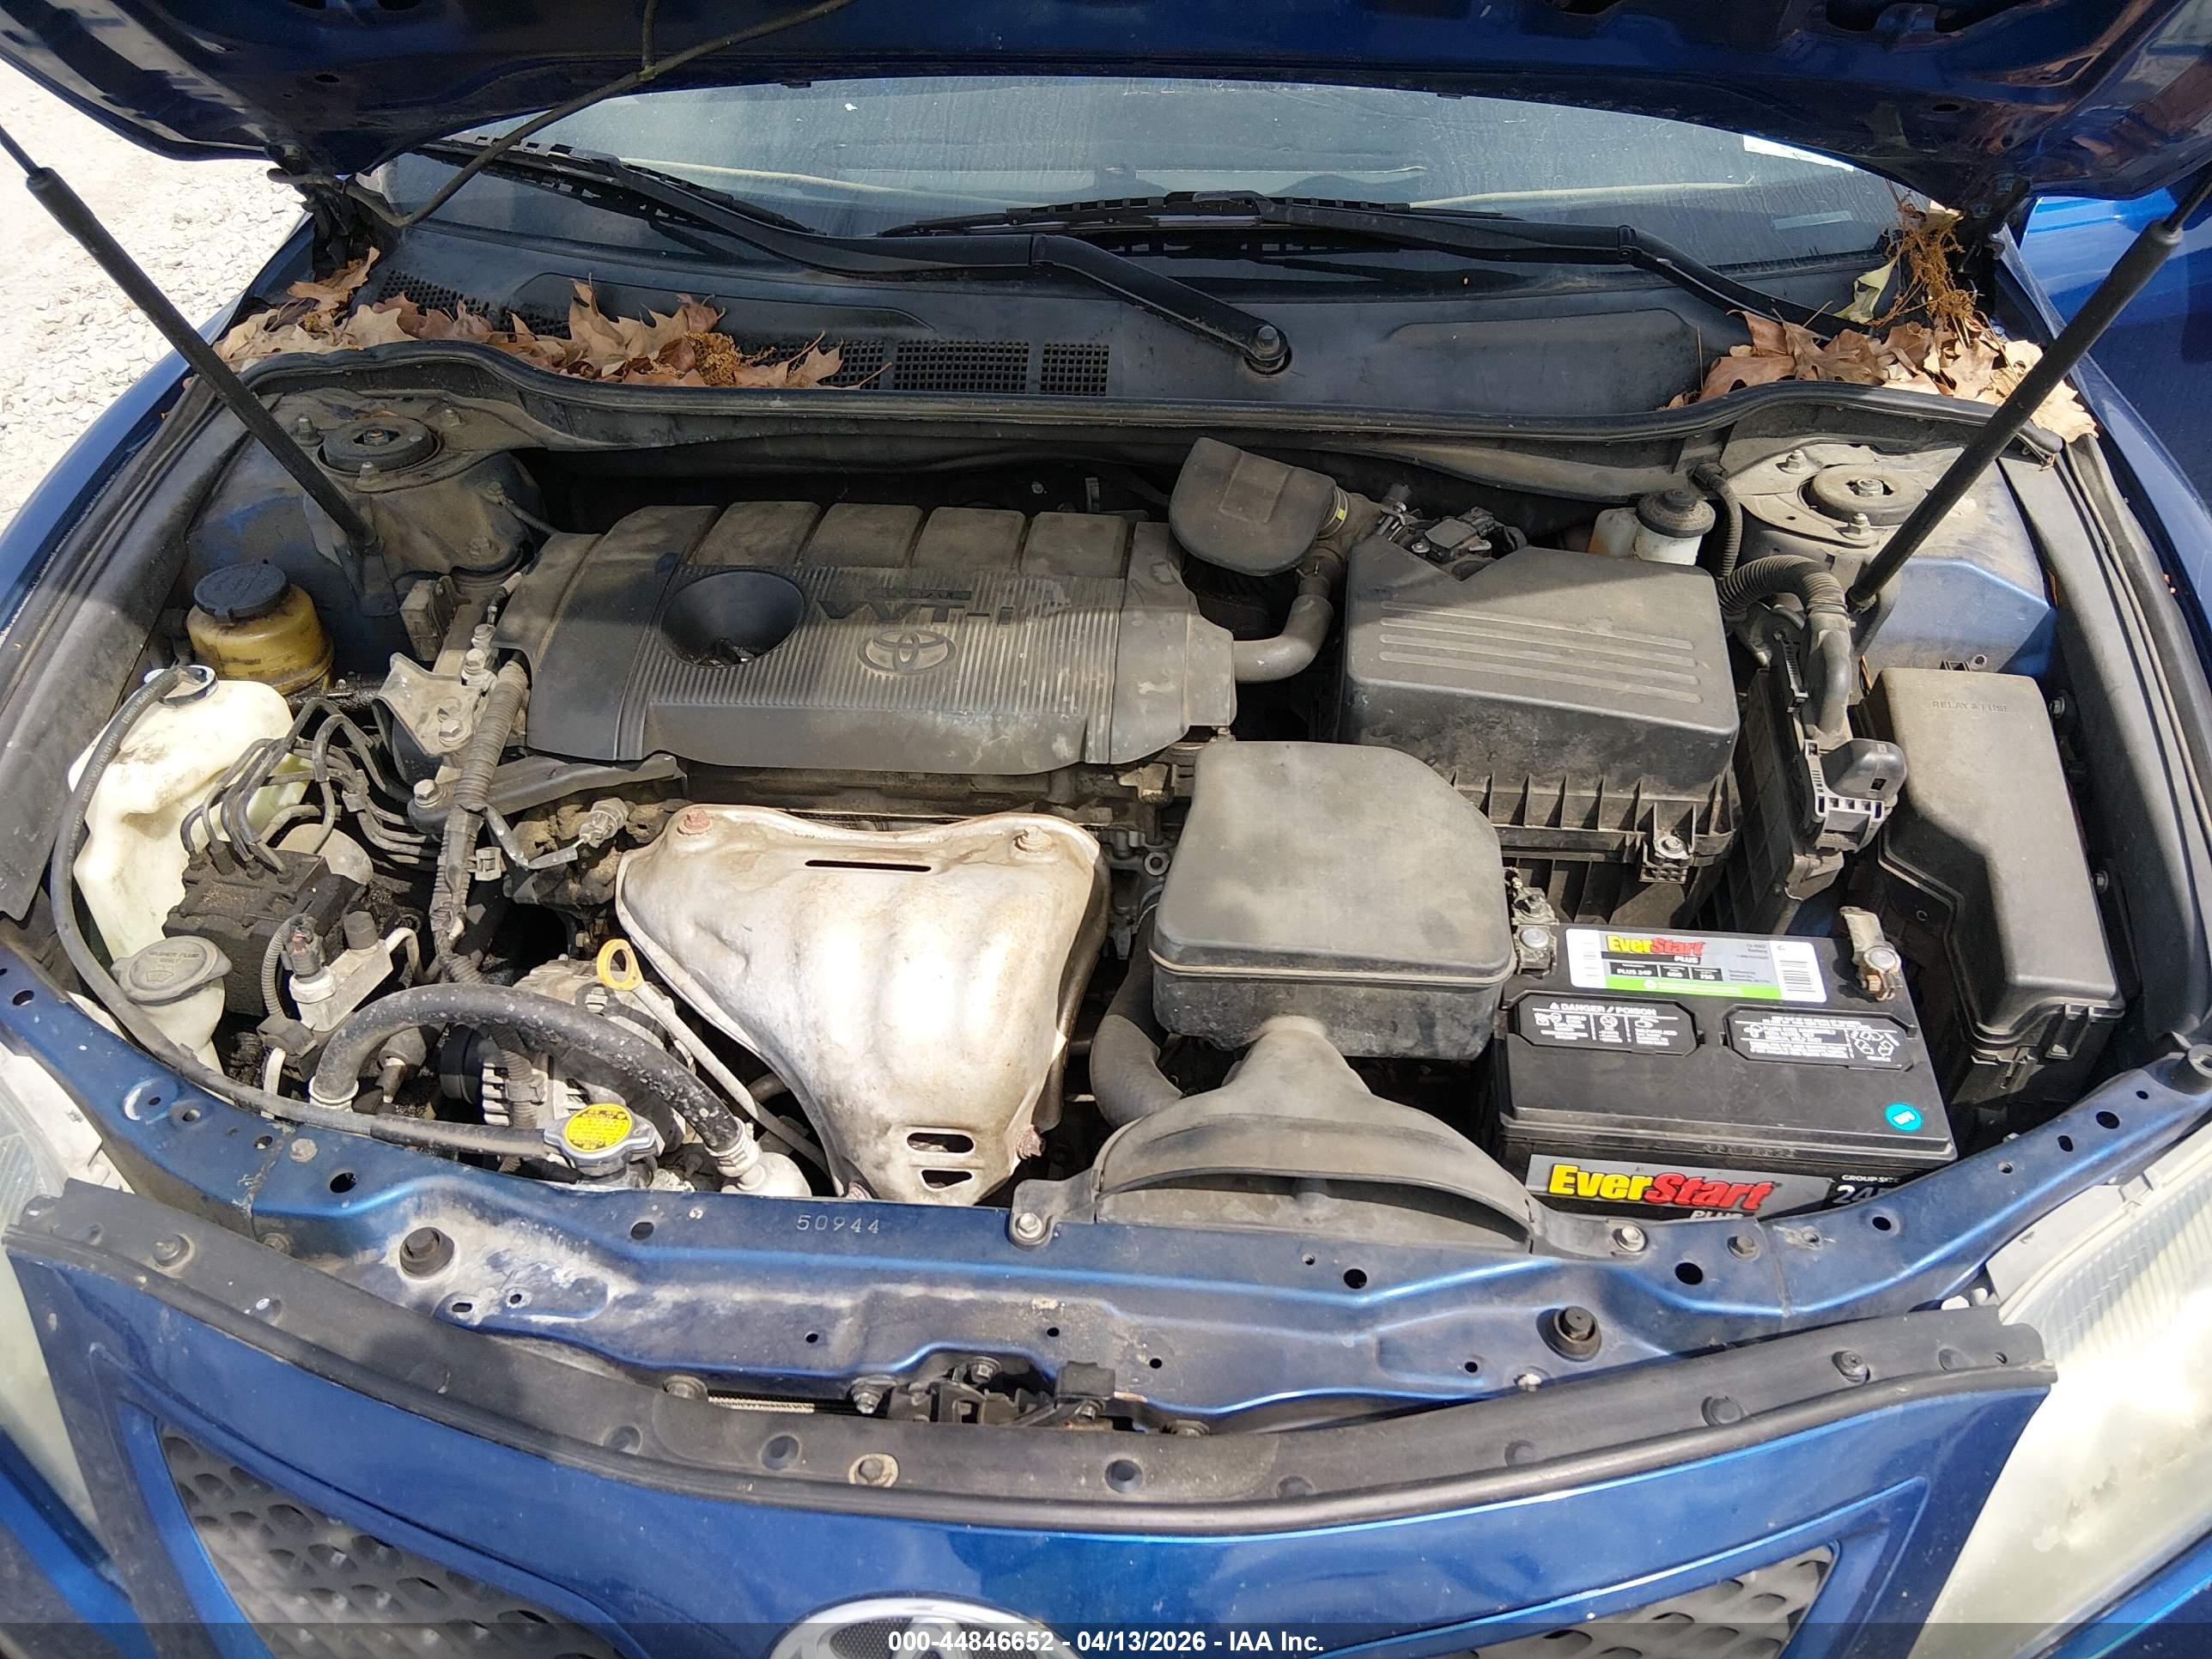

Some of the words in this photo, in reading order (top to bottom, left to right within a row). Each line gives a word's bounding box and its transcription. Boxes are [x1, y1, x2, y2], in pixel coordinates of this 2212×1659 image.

[1931, 701, 1968, 709] RELAY
[1981, 702, 2011, 713] FUSE
[1606, 934, 1706, 957] EverStart
[1548, 1163, 1774, 1210] EverStart
[1841, 1174, 1878, 1182] GROUP
[796, 1214, 879, 1234] 50944
